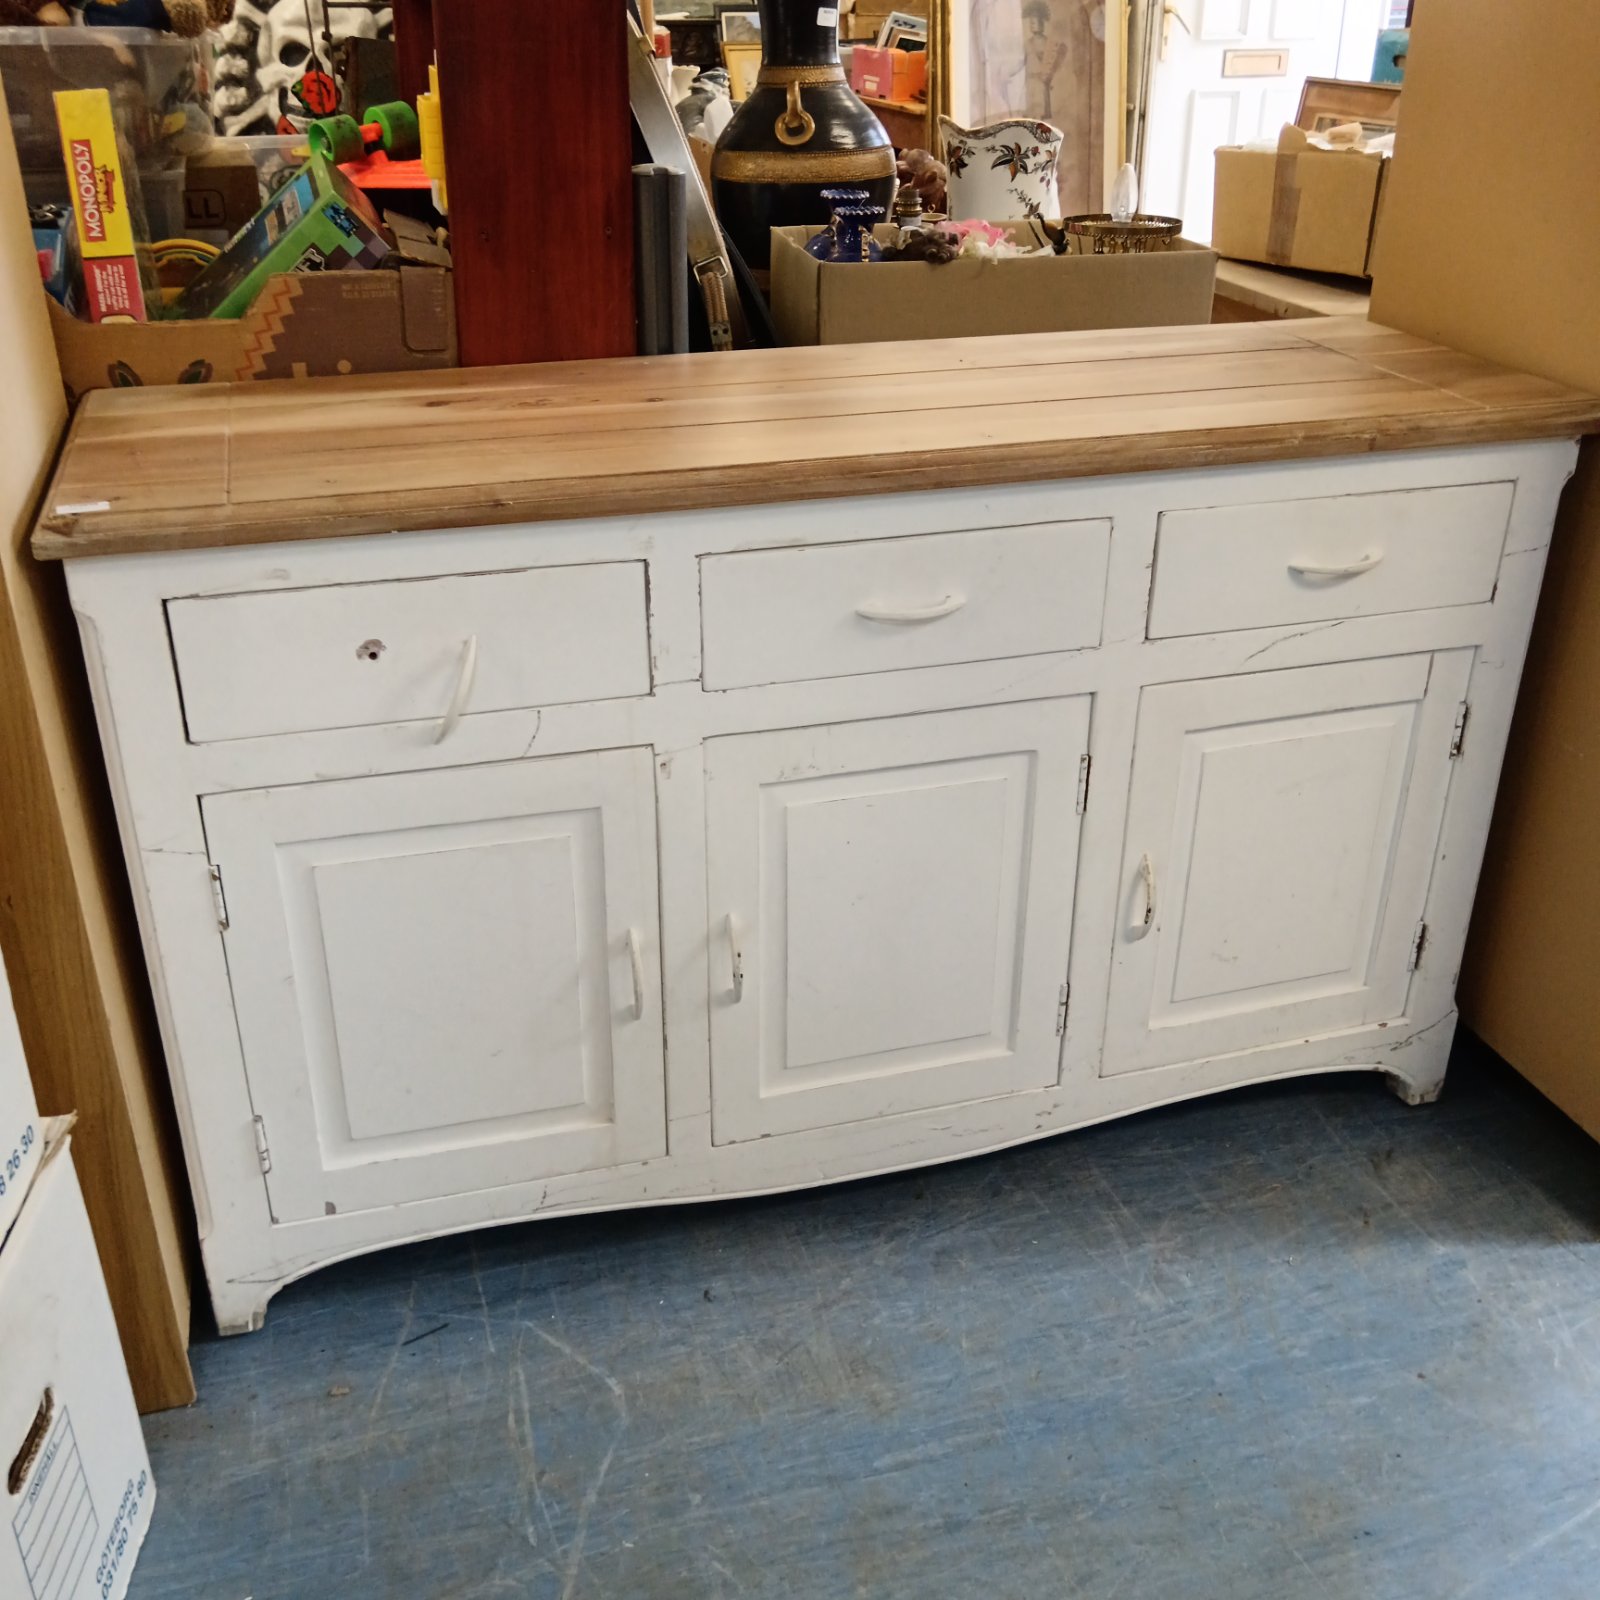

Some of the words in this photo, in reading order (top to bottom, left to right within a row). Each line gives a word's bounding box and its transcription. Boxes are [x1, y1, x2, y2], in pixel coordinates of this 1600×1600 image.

[74, 143, 103, 237] MONOPOLY
[6, 1148, 20, 1181] 26
[21, 1124, 34, 1154] 30
[102, 1527, 128, 1600] 031/80
[127, 1497, 138, 1526] 75
[137, 1469, 147, 1498] 80
